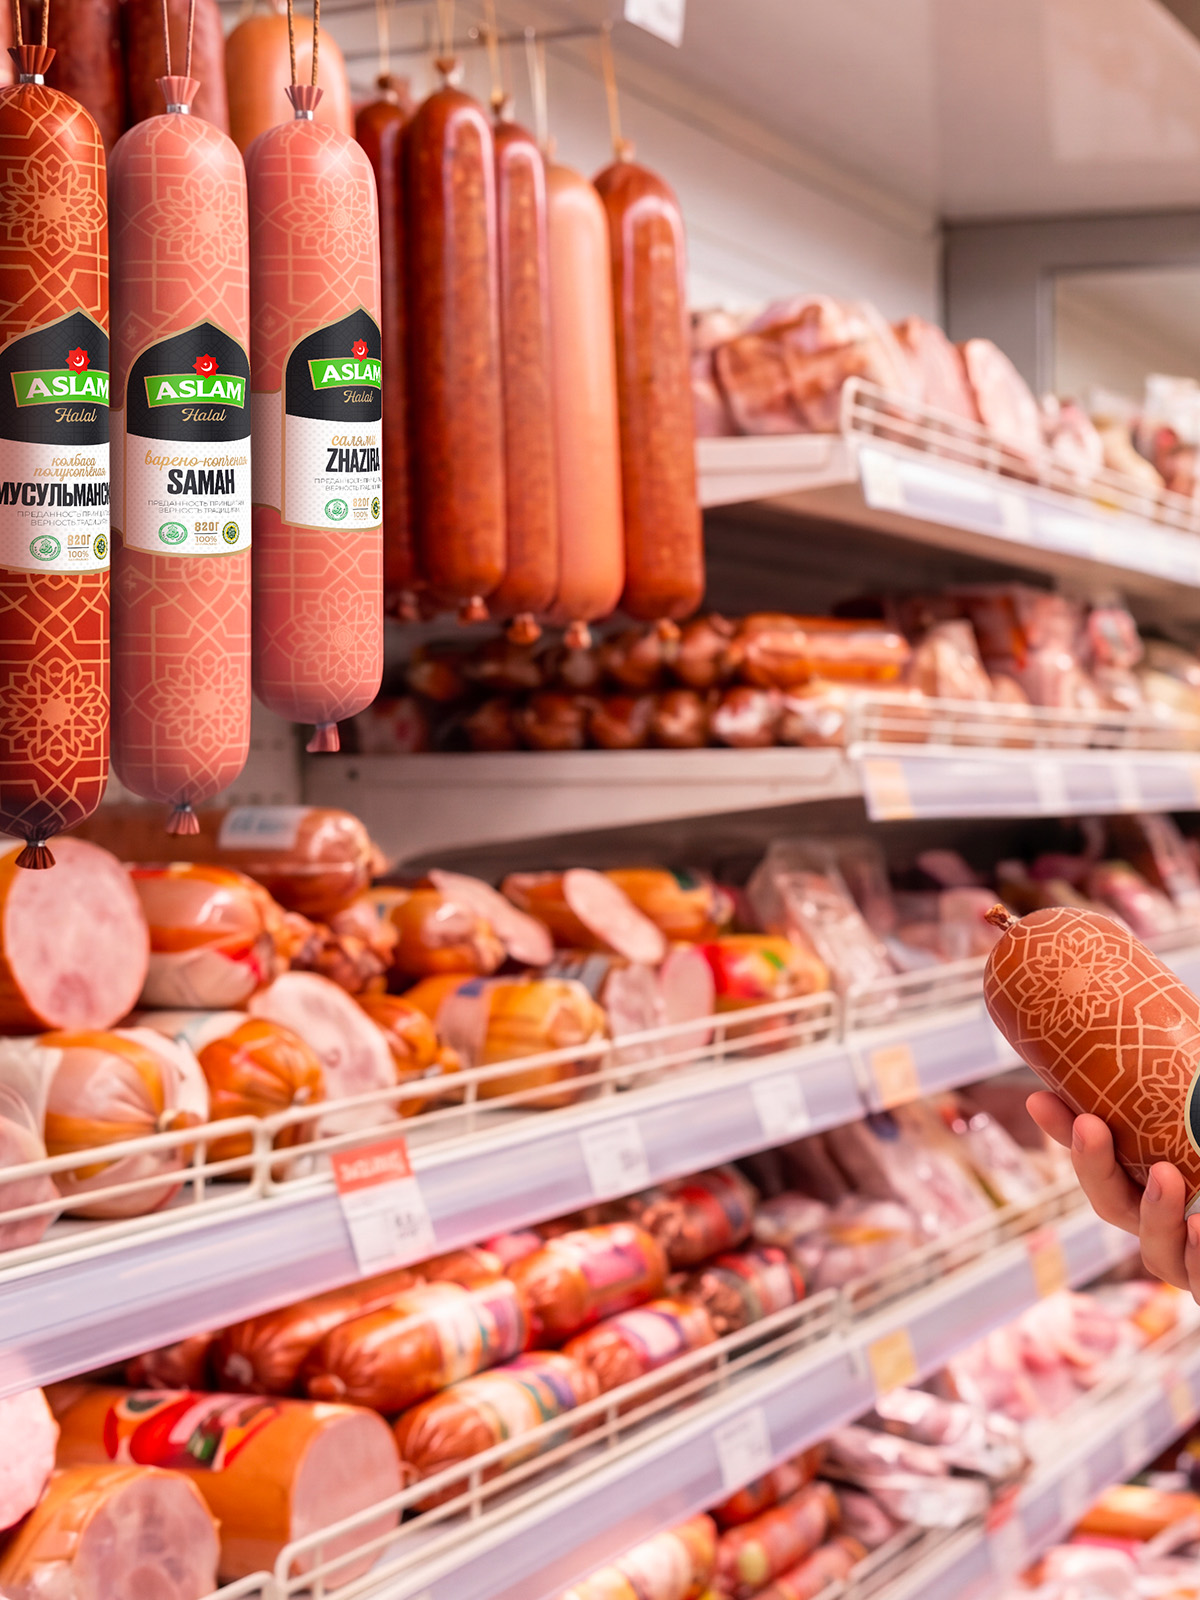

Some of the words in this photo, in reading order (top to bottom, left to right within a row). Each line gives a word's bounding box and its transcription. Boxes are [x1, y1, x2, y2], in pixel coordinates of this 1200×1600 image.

[321, 363, 381, 384] ASLAM
[25, 376, 109, 400] ASLAM
[155, 380, 242, 401] ASLAM
[343, 389, 374, 403] Halal
[54, 407, 98, 423] Halal
[181, 407, 227, 422] Halal
[51, 453, 97, 467] колбаса
[325, 447, 380, 473] ZHAZIRA
[167, 468, 235, 495] SAMAH
[17, 510, 81, 519] ПРЕДАННОСТЬ
[195, 535, 217, 543] 100%
[68, 549, 89, 558] 100%
